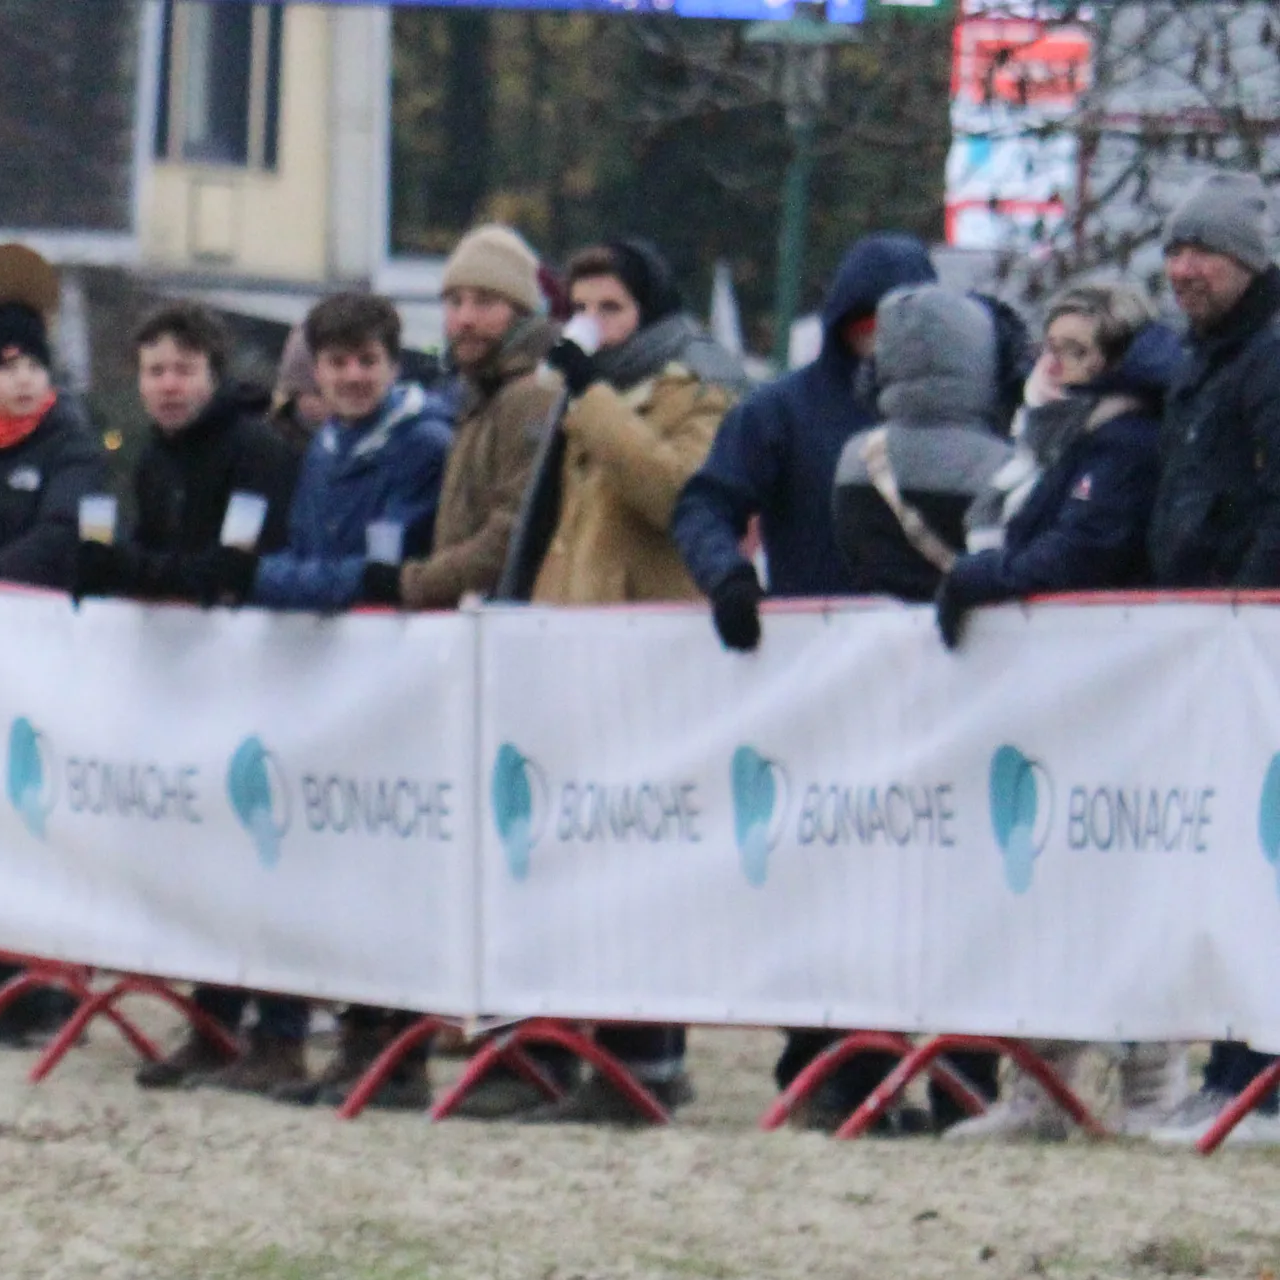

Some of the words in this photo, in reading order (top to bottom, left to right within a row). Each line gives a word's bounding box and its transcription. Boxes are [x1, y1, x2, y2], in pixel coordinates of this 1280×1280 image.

[304, 774, 454, 841] BONACHE
[557, 784, 702, 842] BONACHE
[797, 784, 957, 848] BONACHE
[1067, 785, 1216, 852] BONACHE
